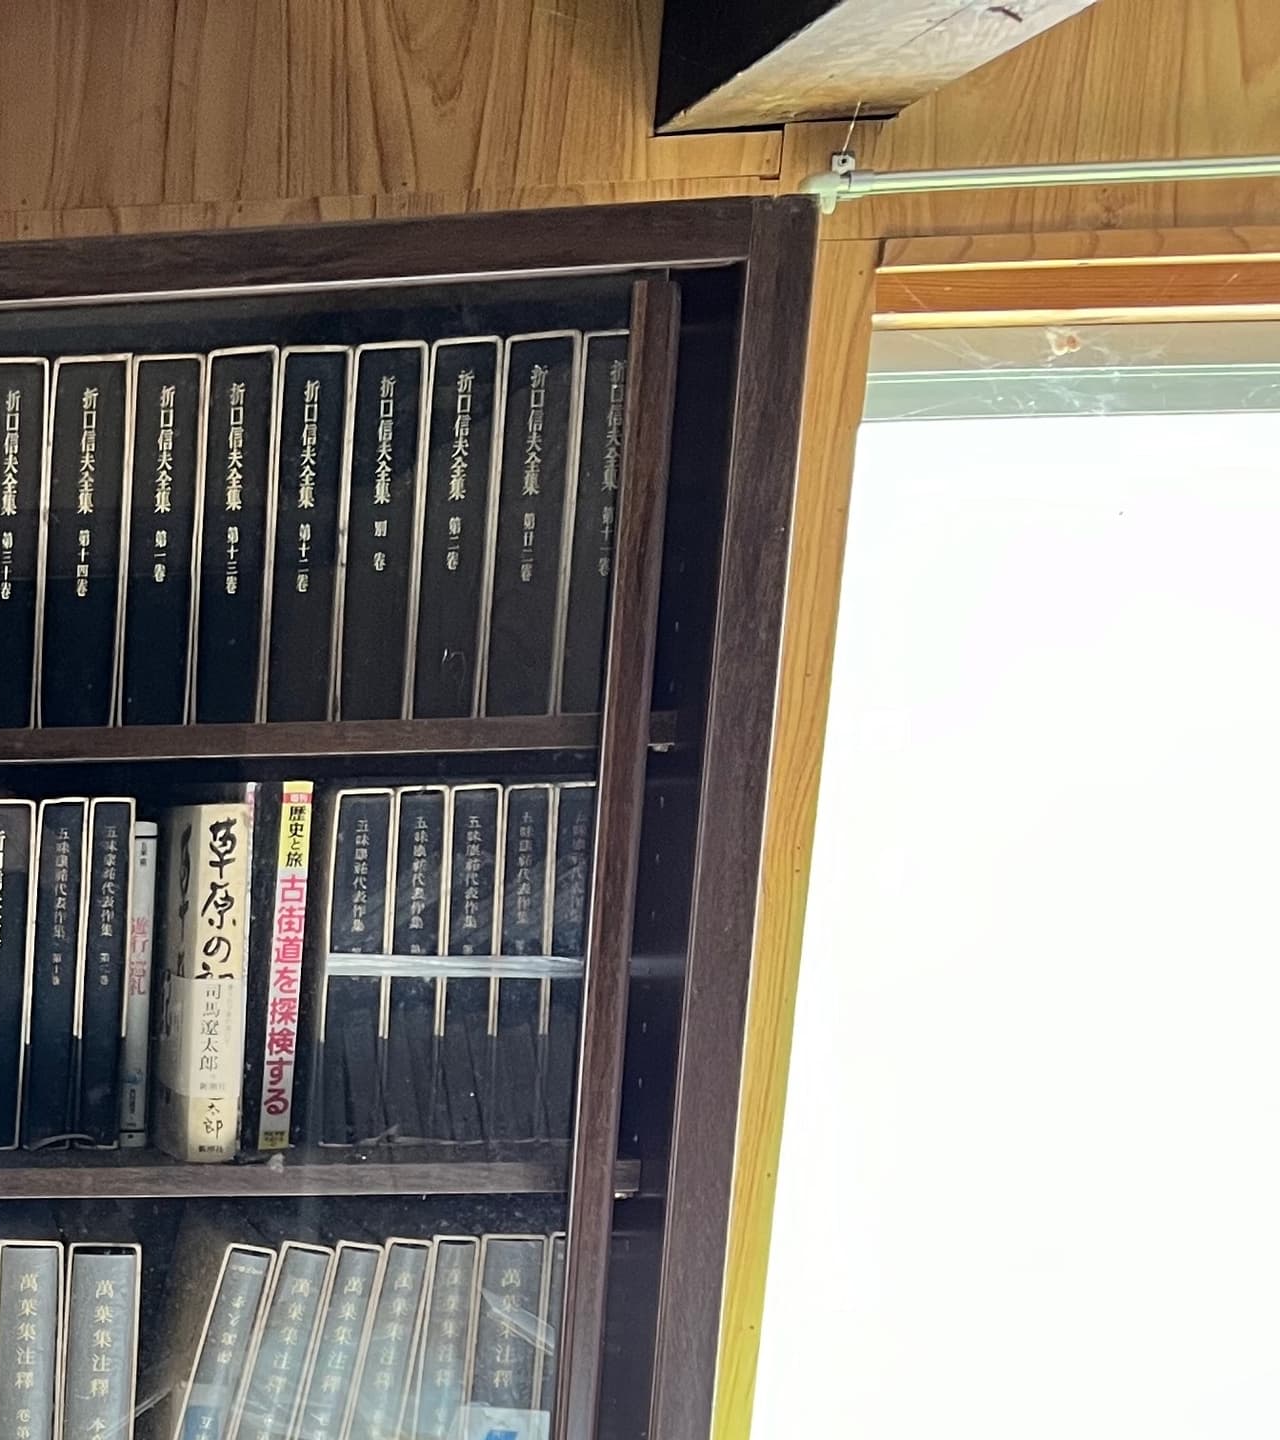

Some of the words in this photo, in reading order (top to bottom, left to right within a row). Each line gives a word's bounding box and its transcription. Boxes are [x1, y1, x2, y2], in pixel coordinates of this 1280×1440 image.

[0, 389, 21, 516] 折口信夫全集
[77, 387, 99, 515] 折口信夫全集
[154, 385, 176, 513] 折口信夫全集
[225, 382, 246, 511] 折口信夫全集
[297, 380, 321, 509] 折口信夫全集
[373, 375, 396, 504] 折口信夫全集
[448, 369, 475, 501] 折口信夫全集
[522, 364, 549, 496] 折口信夫全集
[285, 805, 308, 868] 歴史と旅
[200, 984, 222, 1072] 司馬遼太郎
[263, 874, 307, 1115] 古街道を探検する
